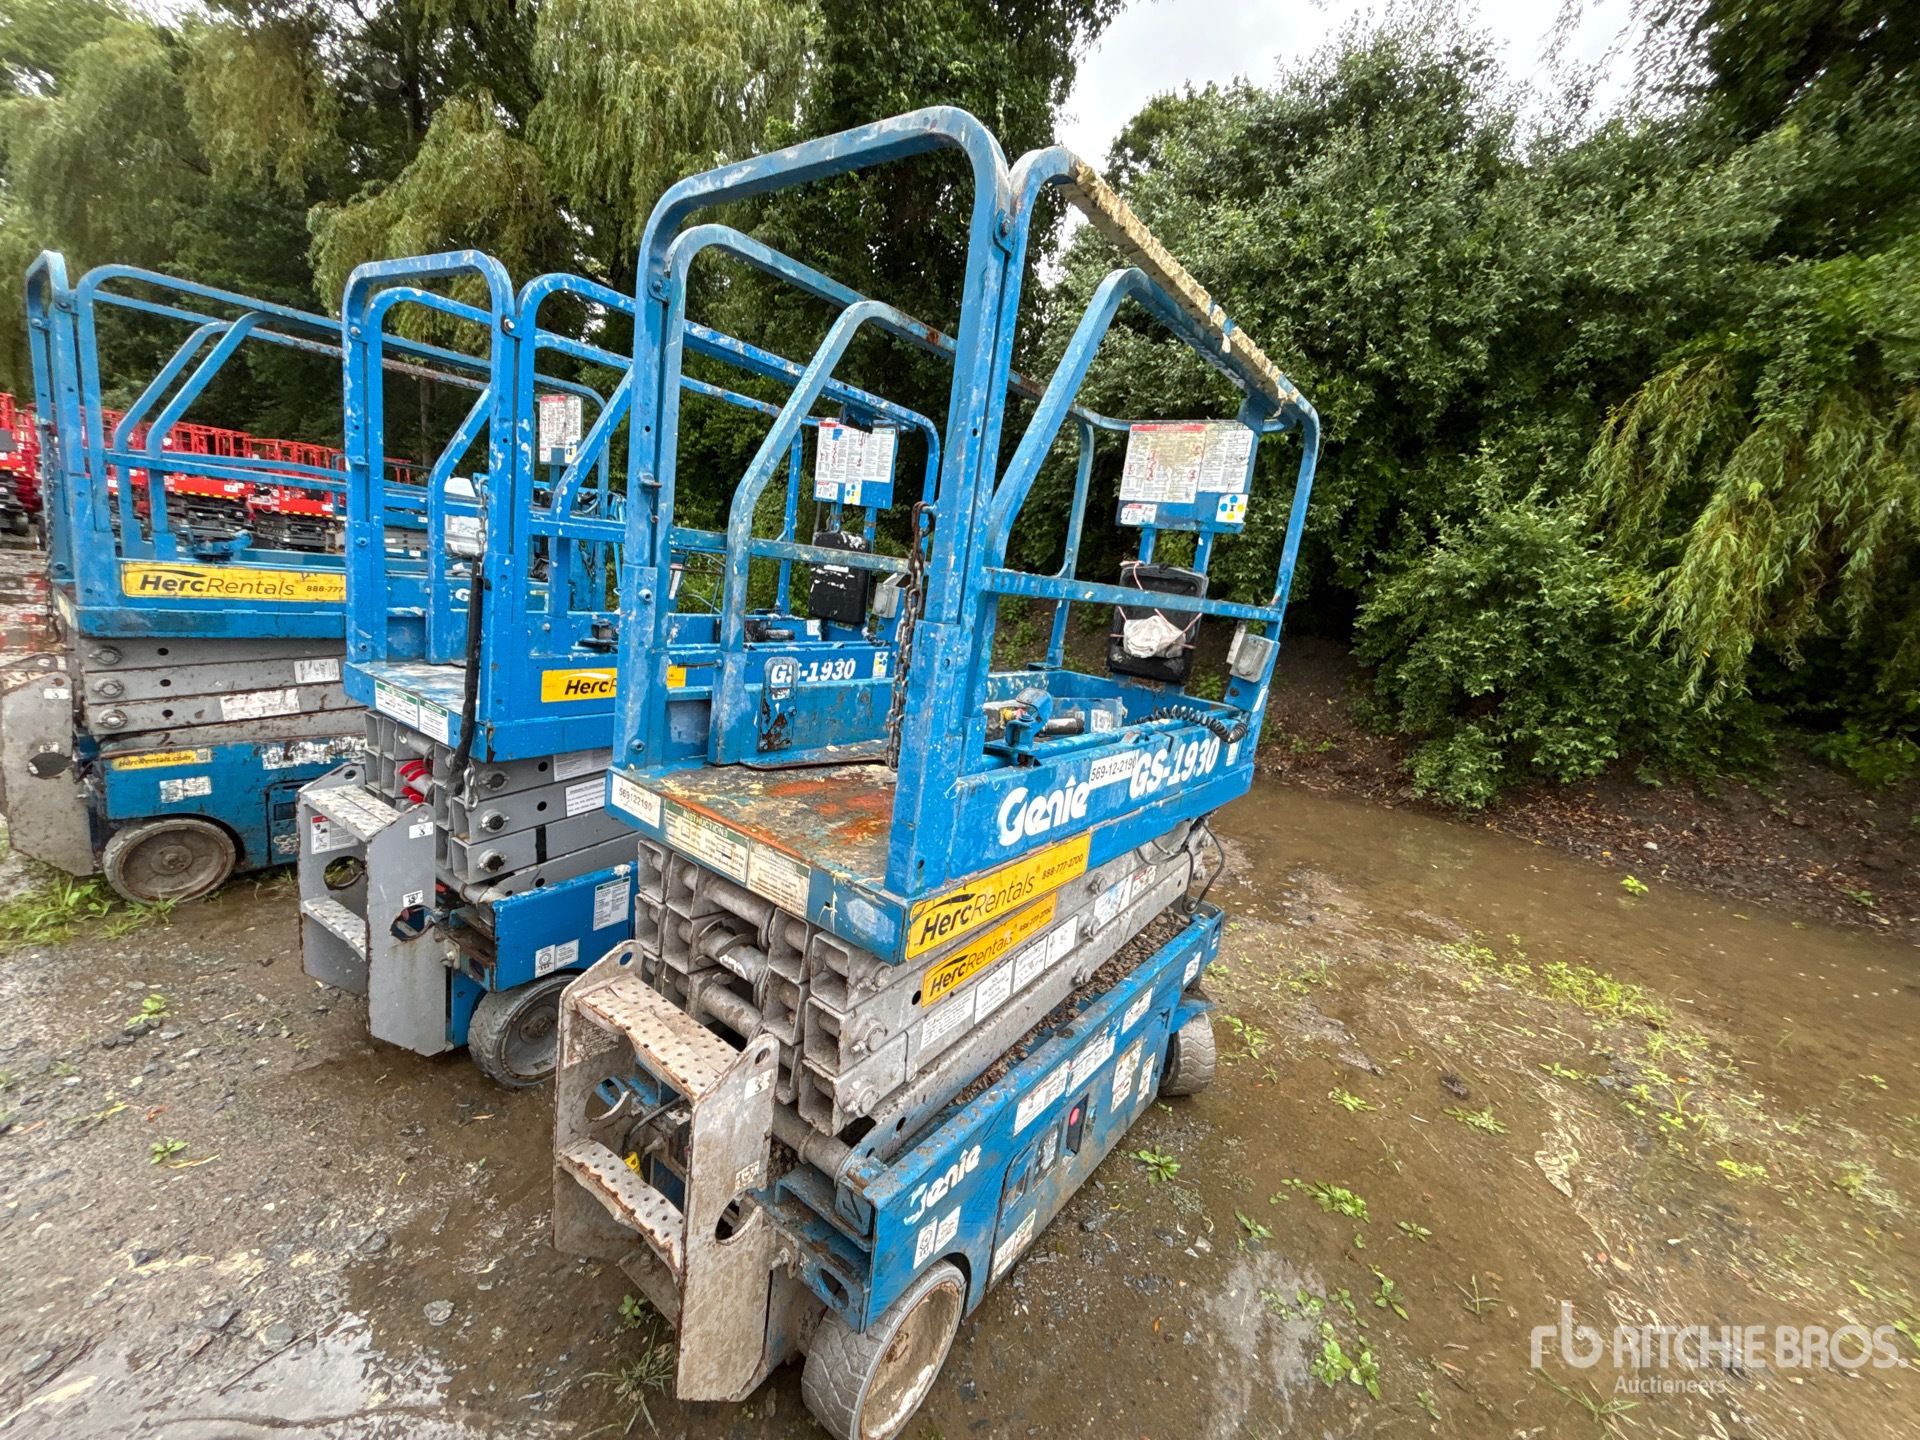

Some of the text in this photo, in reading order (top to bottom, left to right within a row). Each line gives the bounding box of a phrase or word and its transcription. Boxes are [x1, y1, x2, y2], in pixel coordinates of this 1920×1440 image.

[140, 575, 294, 596] HercRentals
[1090, 757, 1137, 782] 569-12-2190
[1129, 736, 1221, 799] GS-1930
[618, 787, 653, 812] 569122190
[997, 775, 1091, 846] Genie
[919, 873, 1035, 946] HercRentals
[1041, 853, 1084, 880] 888-777-2700
